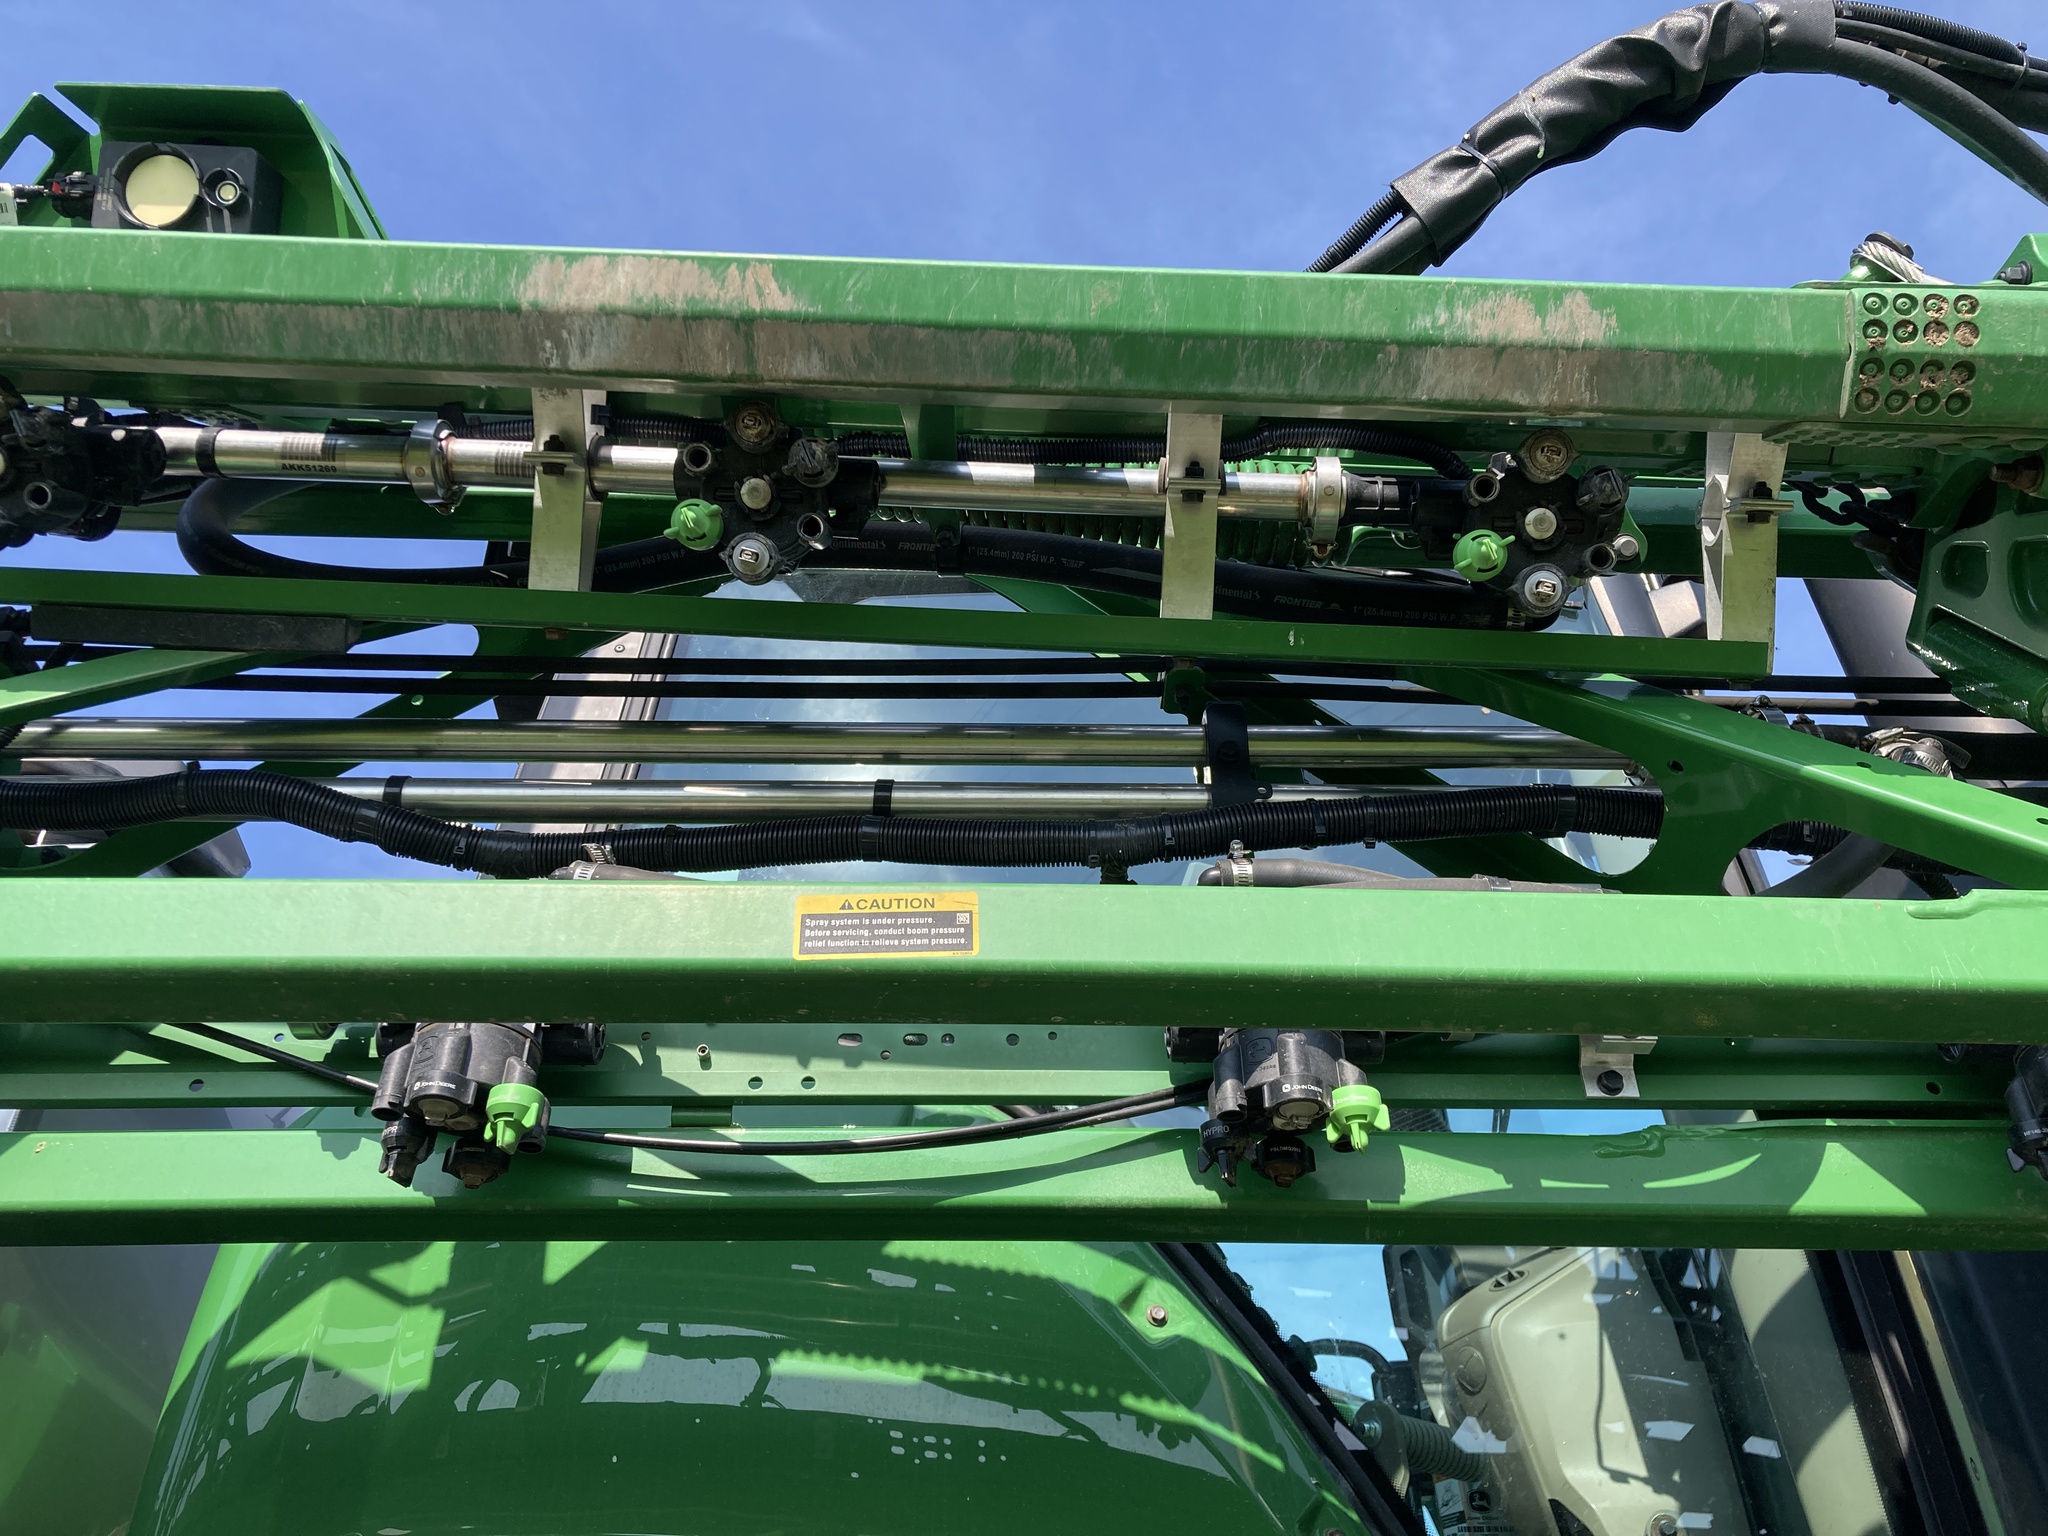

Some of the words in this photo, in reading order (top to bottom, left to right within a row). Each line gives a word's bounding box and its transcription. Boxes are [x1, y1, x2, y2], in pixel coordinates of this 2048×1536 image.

[282, 463, 338, 473] AKK51269
[898, 542, 936, 552] FRONTIE
[977, 548, 1010, 560] (25.4mm)
[1012, 552, 1025, 561] 200
[1026, 553, 1039, 562] PSI
[1041, 555, 1057, 565] W.P.
[604, 559, 641, 574] (25.4mm)
[641, 556, 655, 566] 200
[656, 552, 671, 562] PSI
[1214, 585, 1252, 599] tinental
[1273, 595, 1323, 608] FRONTIER
[1364, 608, 1402, 618] (25.4mm)
[1405, 611, 1420, 619] 200
[1422, 612, 1437, 621] PSI
[856, 897, 936, 911] CAUTION
[805, 918, 829, 928] Spray
[831, 917, 860, 927] system
[862, 917, 870, 925] is
[872, 916, 896, 925] under
[897, 916, 936, 926] pressure.
[805, 929, 831, 937] Before
[832, 928, 873, 937] servicing,
[874, 927, 906, 936] conduct
[907, 927, 929, 935] boom
[930, 926, 965, 936] pressure
[804, 940, 826, 948] relief
[827, 939, 860, 948] function
[861, 938, 870, 946] to
[872, 938, 899, 946] relieve
[900, 937, 929, 947] system
[930, 937, 968, 947] pressure.
[435, 1080, 457, 1090] DEERE
[1203, 1125, 1230, 1138] HYPRO
